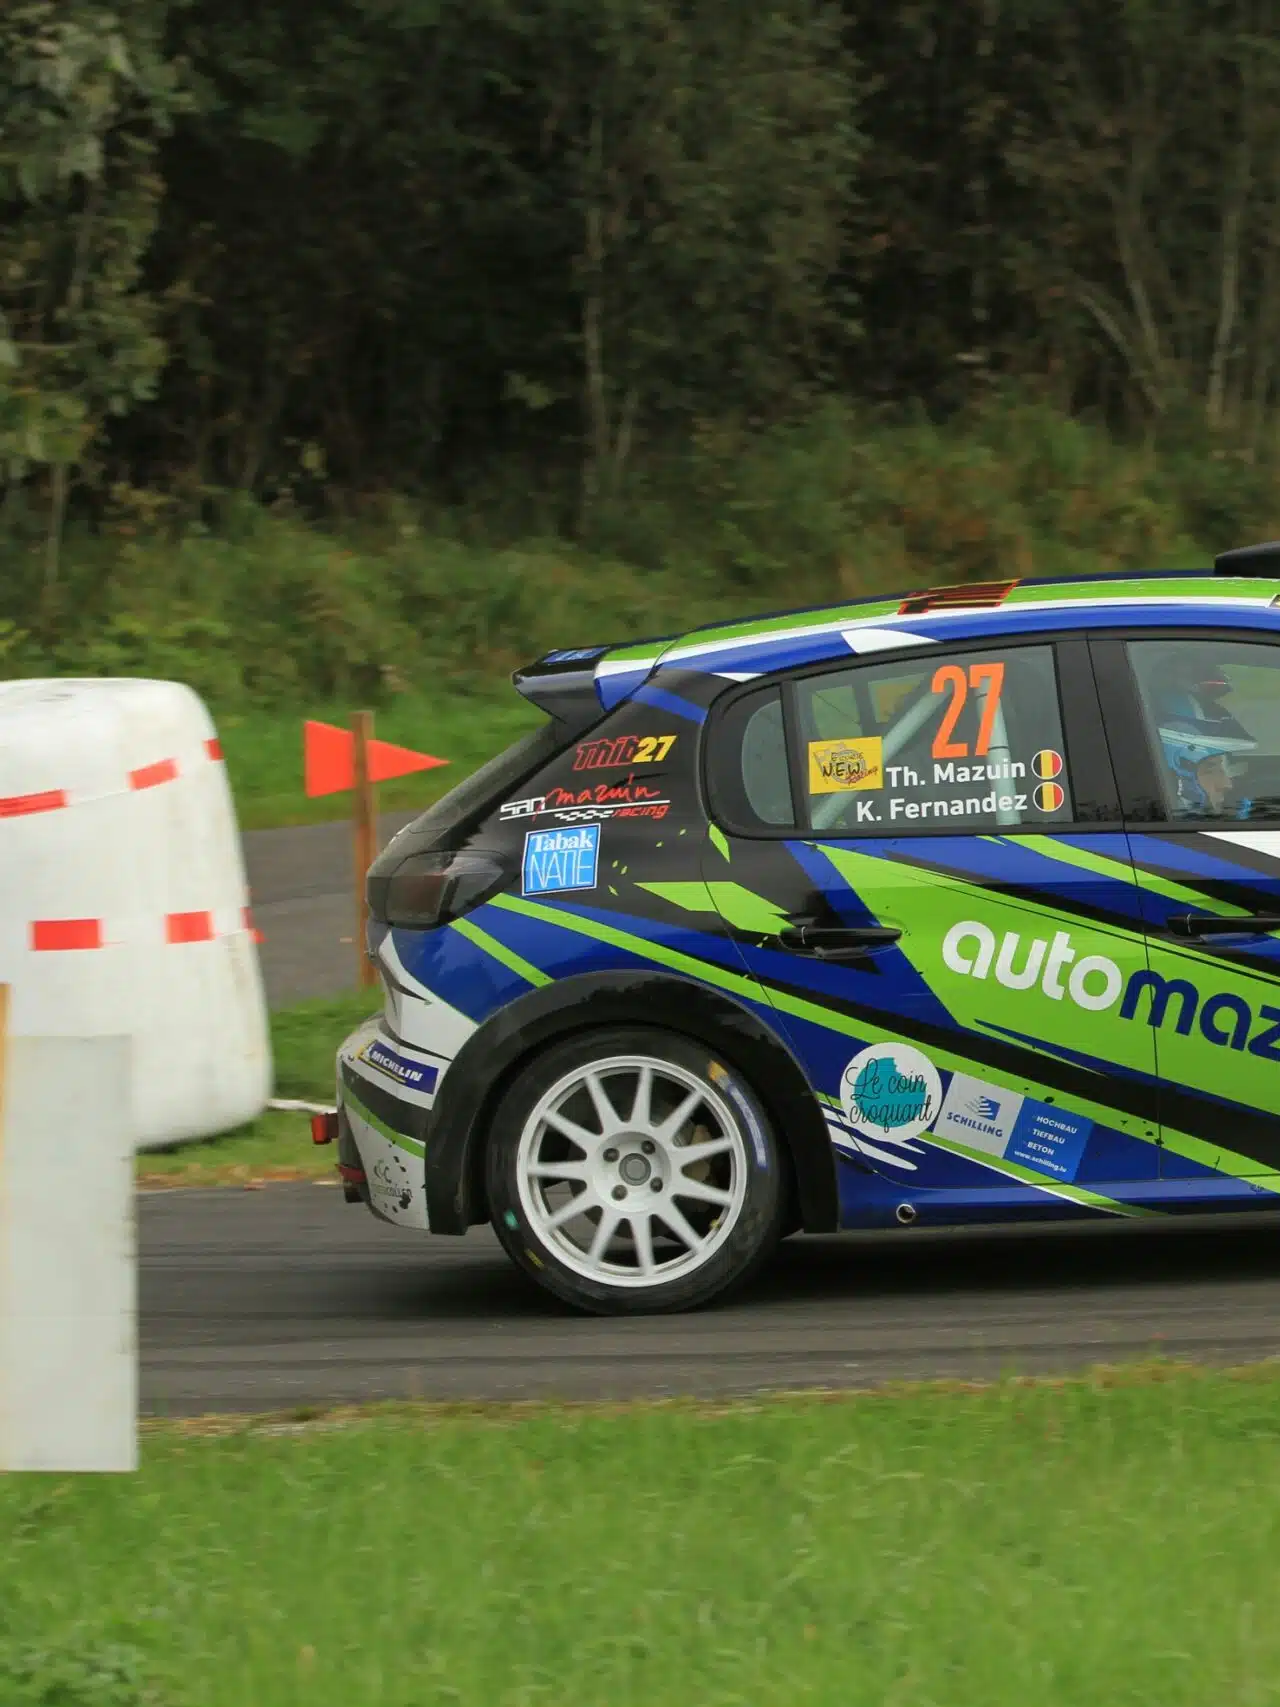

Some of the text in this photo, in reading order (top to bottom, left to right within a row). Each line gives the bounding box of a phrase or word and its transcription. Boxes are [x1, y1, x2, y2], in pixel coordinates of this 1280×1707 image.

[931, 663, 1004, 759] 27
[886, 759, 1026, 788] Th. Mazuin
[857, 792, 1027, 822] K. Fernandez
[530, 830, 594, 852] Tabak
[371, 1051, 423, 1081] MICHELIN
[845, 1058, 926, 1100] Le coin
[849, 1094, 932, 1133] croquant
[946, 1111, 1003, 1137] SCHILLING
[1036, 1115, 1078, 1134] HOCHBAU
[1027, 1141, 1055, 1155] BETON
[1032, 1128, 1066, 1144] TIEFBAU
